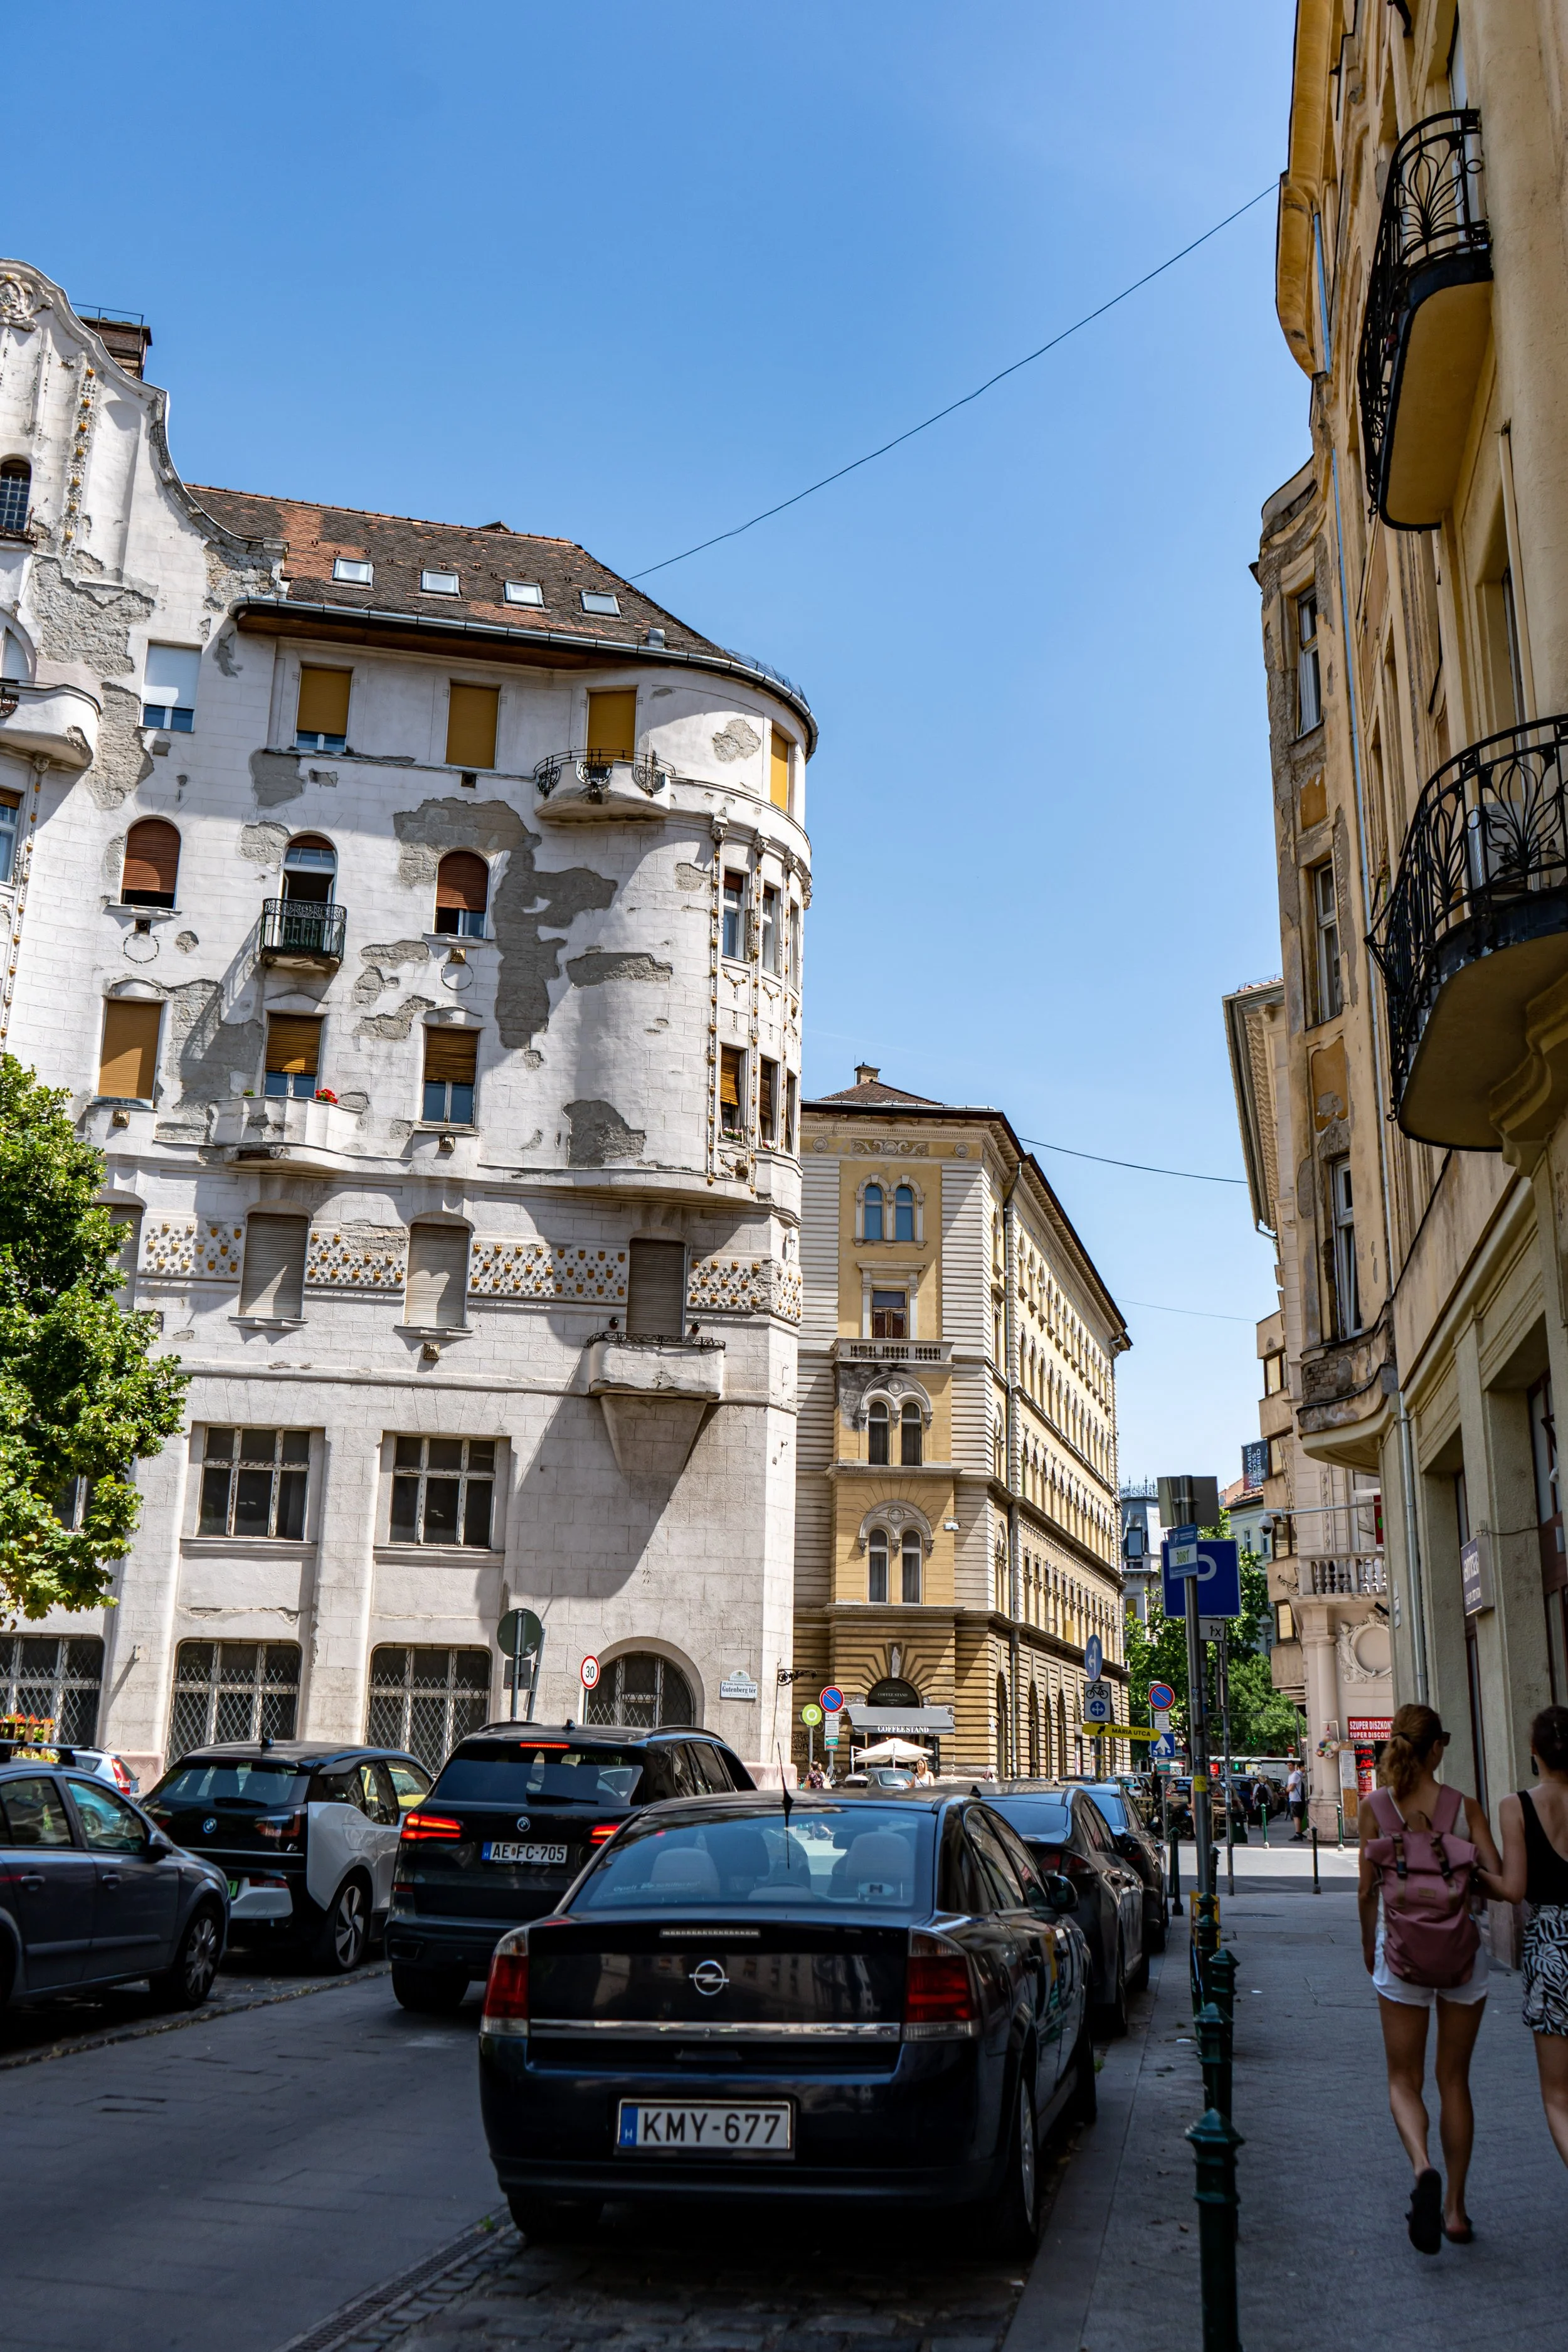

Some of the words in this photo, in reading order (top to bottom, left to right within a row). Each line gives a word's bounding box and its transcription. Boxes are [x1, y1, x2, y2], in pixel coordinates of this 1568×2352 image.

[585, 1666, 595, 1678] 30
[722, 1685, 748, 1694] Gutenberg
[1349, 1720, 1369, 1730] SZUPER
[1111, 1727, 1132, 1735] MÁRIA
[492, 1843, 511, 1859] AE
[516, 1845, 565, 1861] FC-705
[869, 1883, 883, 1893] H
[643, 2112, 781, 2144] KMY-677
